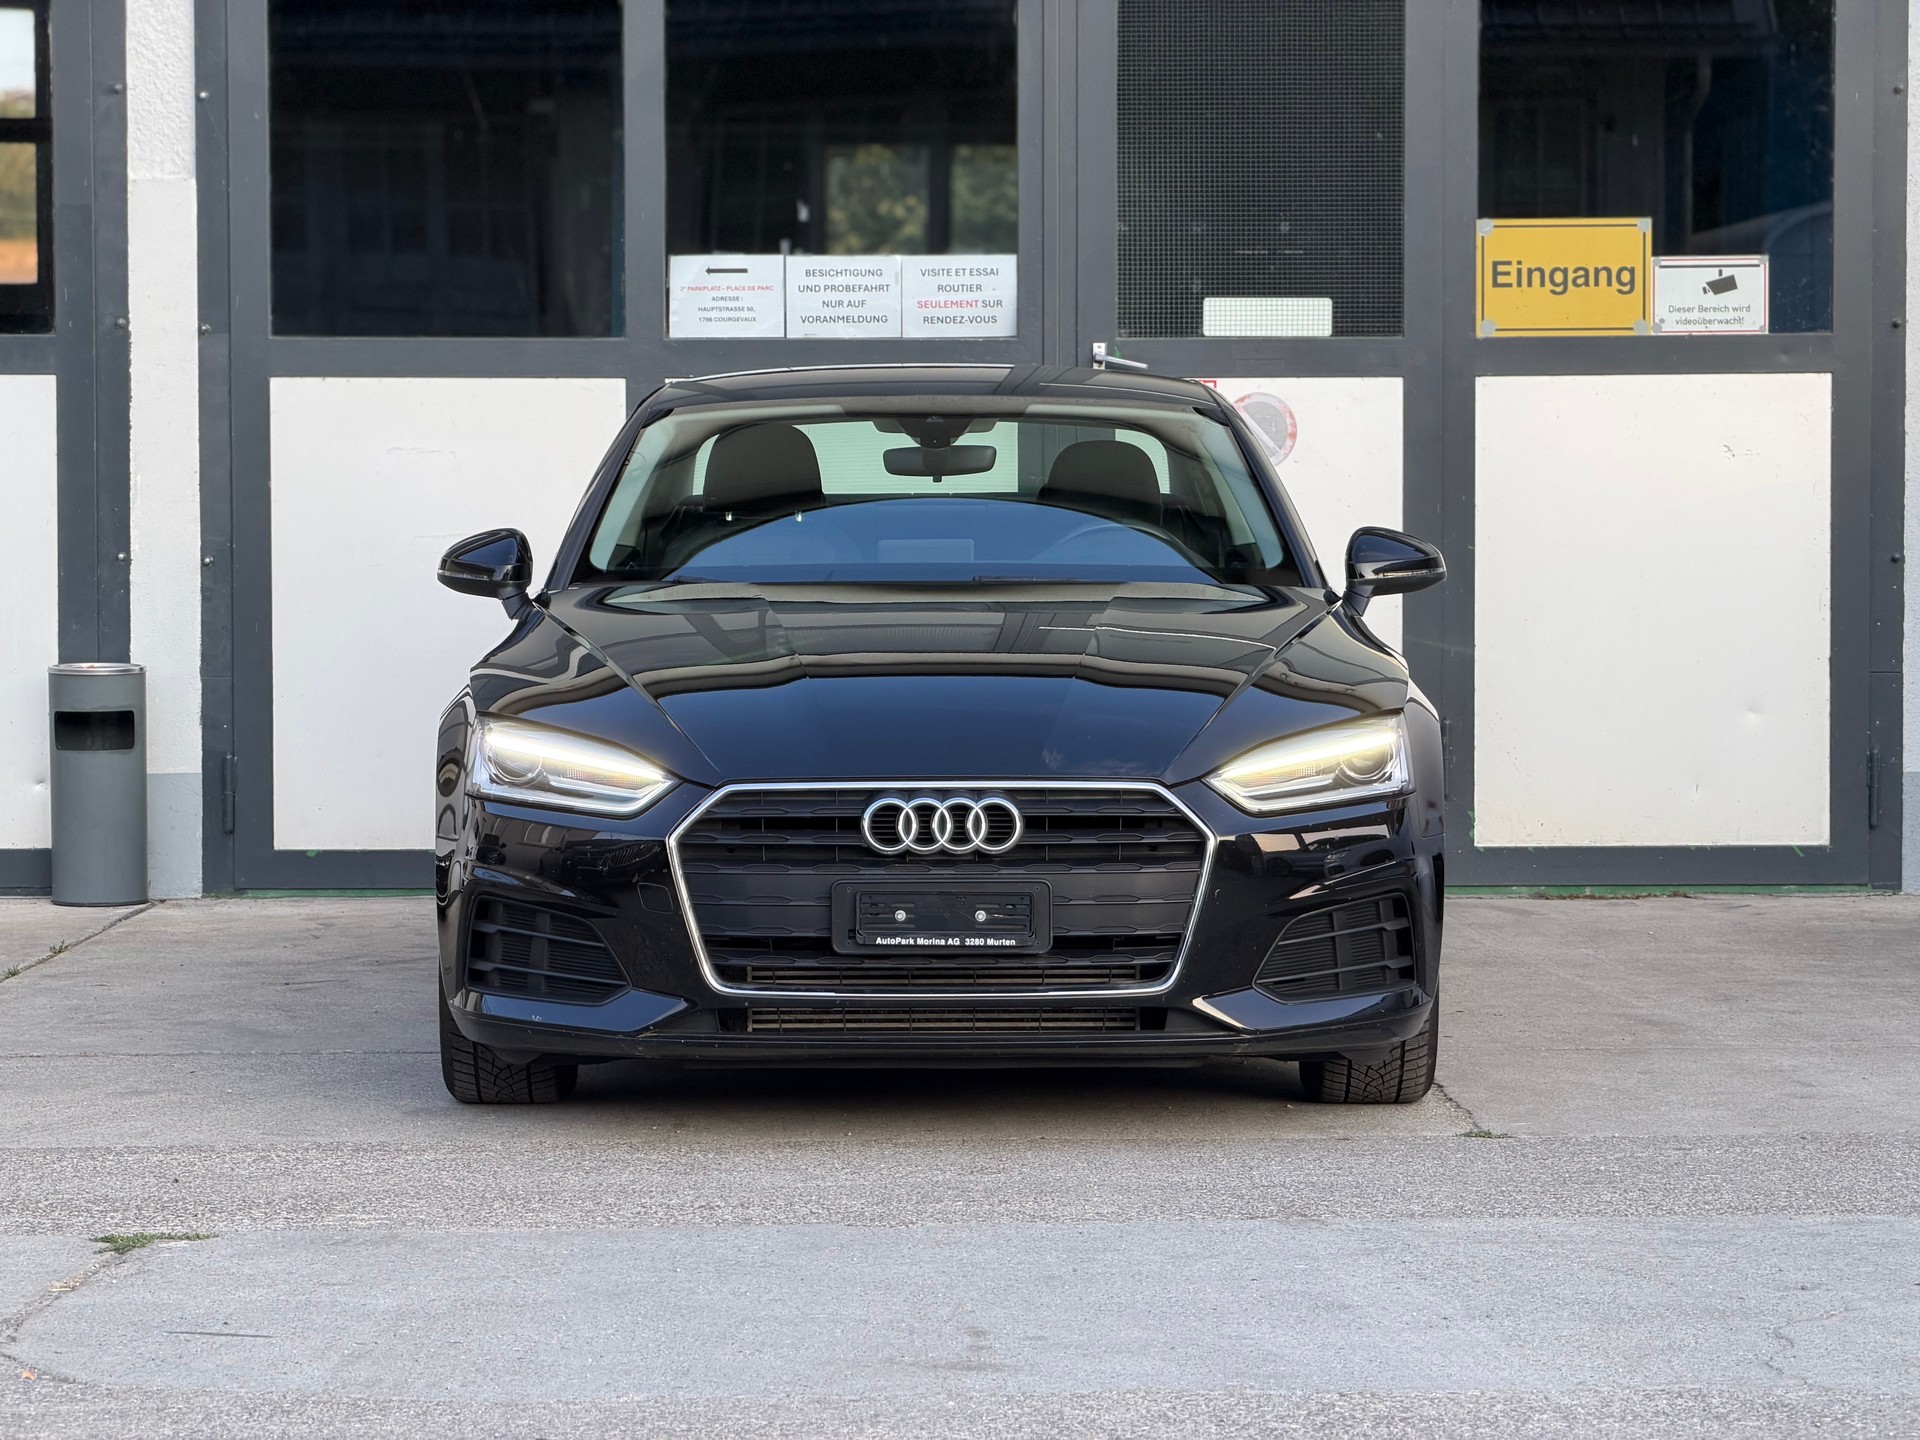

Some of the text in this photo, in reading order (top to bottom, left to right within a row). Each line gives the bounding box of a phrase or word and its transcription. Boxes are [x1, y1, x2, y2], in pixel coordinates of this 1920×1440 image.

[805, 268, 883, 278] BESICHTIGUNG
[920, 268, 999, 277] VISITE ET ESSAI
[1491, 260, 1636, 295] Eingang
[798, 284, 891, 293] UND PROBEFAHRT
[937, 284, 983, 293] ROUTIER
[822, 299, 867, 308] NUR AUF
[917, 300, 1003, 309] SEULEMENT SUR
[1668, 304, 1751, 313] Dieser Bereich wird
[800, 315, 889, 324] VORANMELDUNG
[922, 315, 998, 325] RENDEZ-VOUS
[1675, 316, 1744, 326] videoüberwacht!
[876, 936, 915, 945] AutoPark
[916, 937, 945, 945] Morina
[947, 937, 961, 945] AG
[986, 938, 1016, 946] Murten
